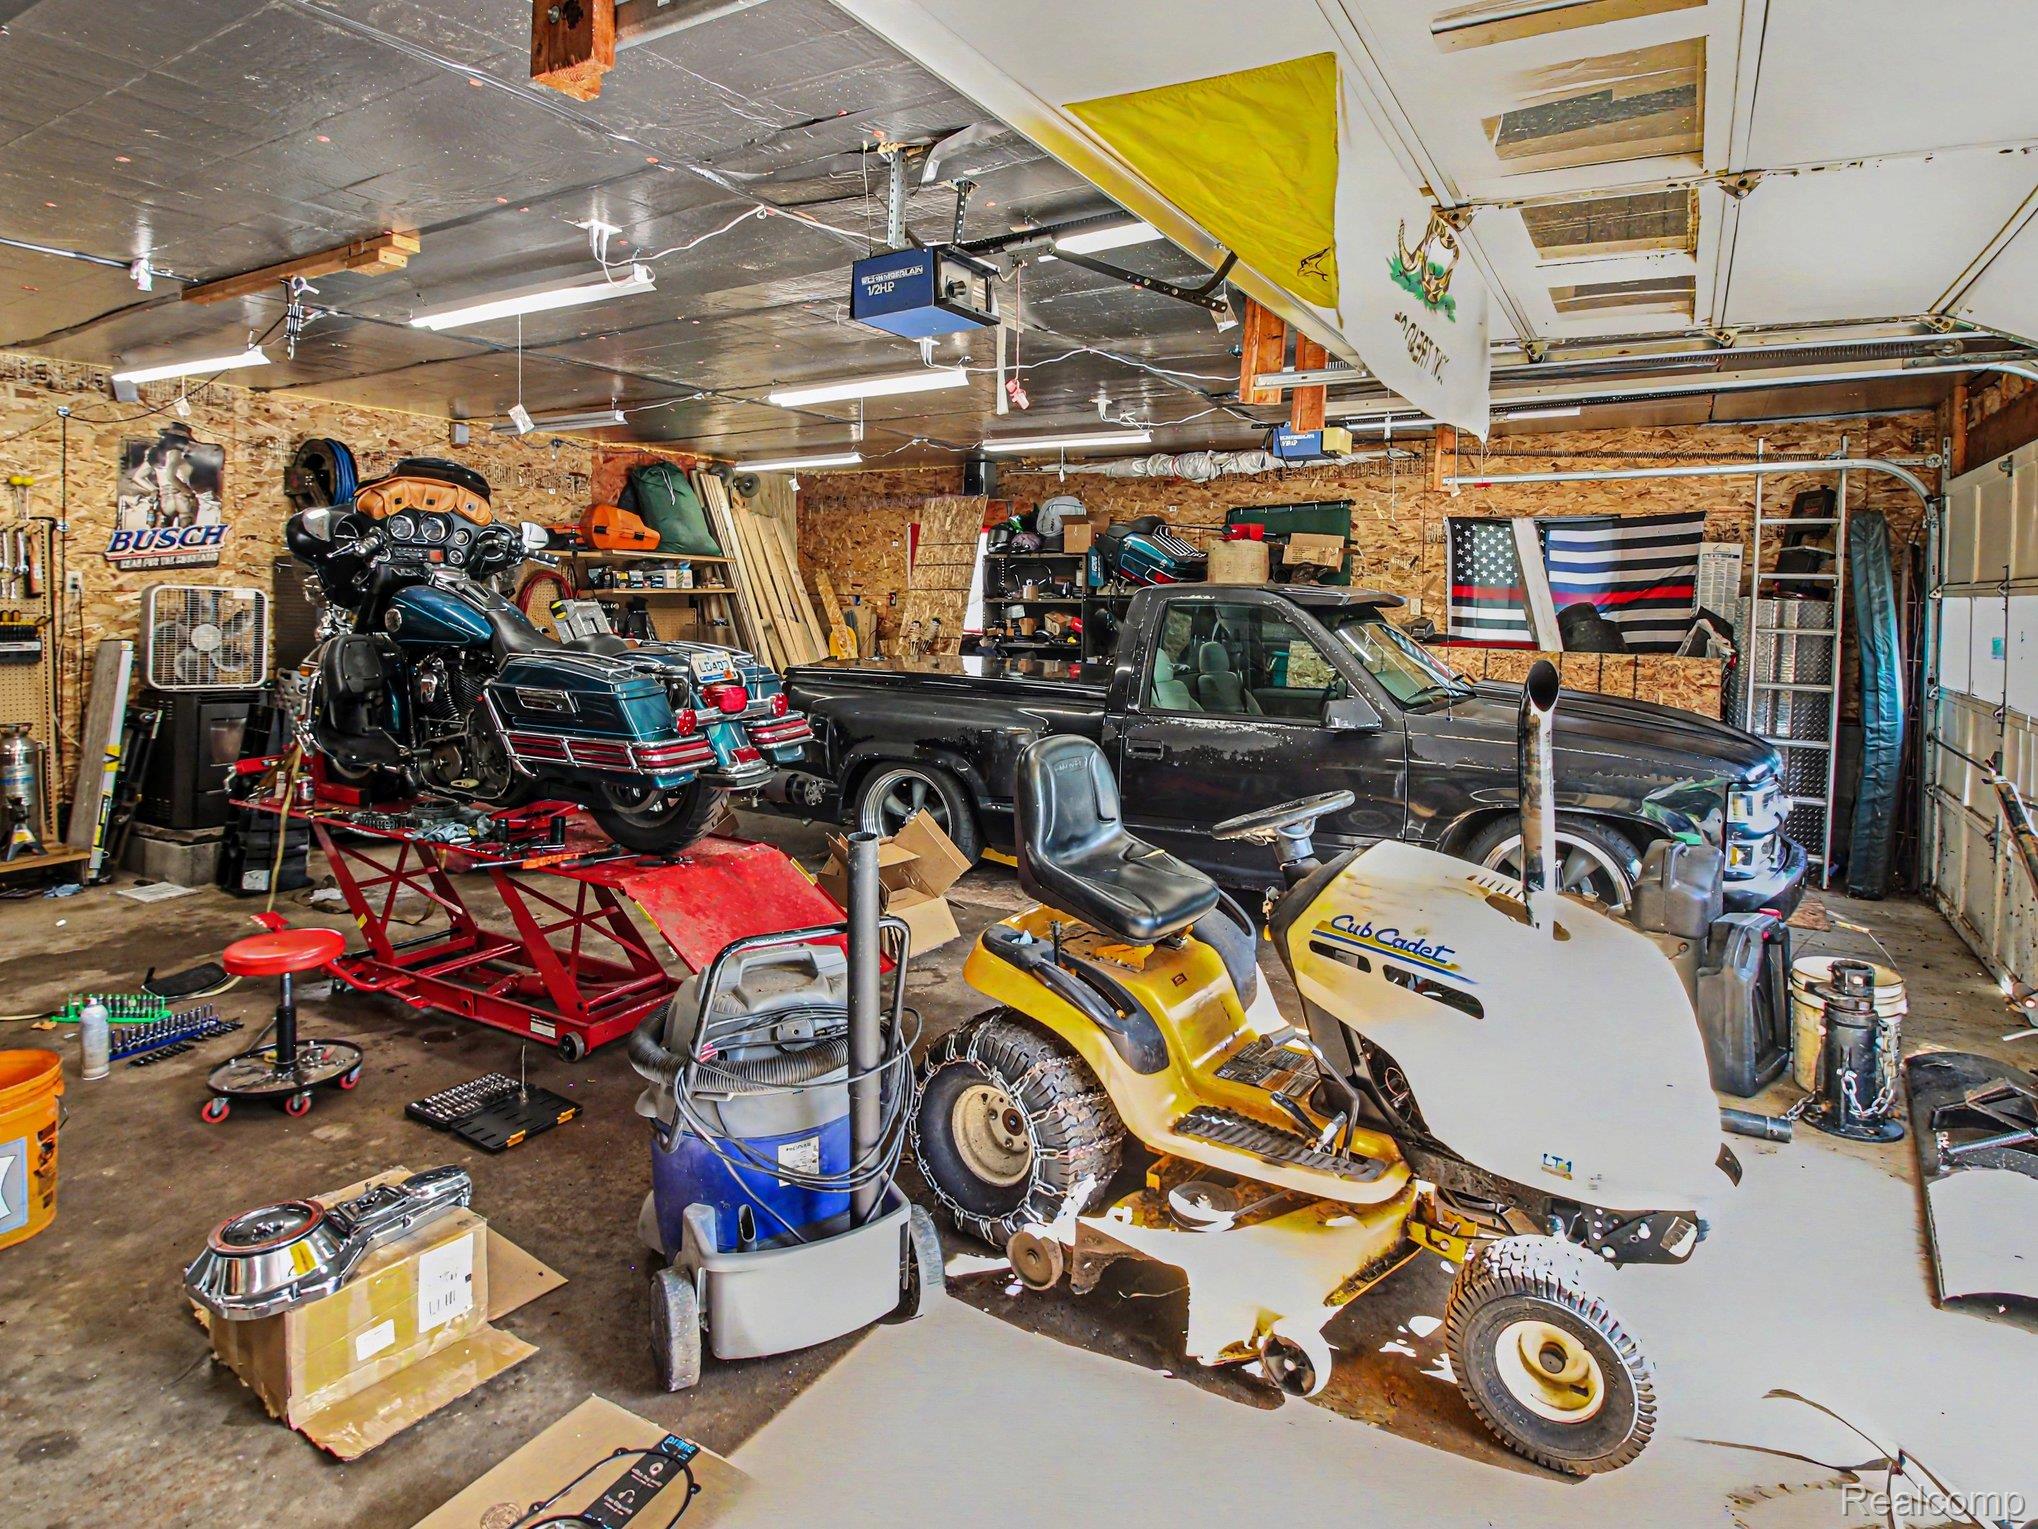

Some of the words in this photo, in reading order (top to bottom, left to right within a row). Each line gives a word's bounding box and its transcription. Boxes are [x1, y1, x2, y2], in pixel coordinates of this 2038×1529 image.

[106, 524, 229, 553] BUSCH
[1331, 914, 1373, 938] Cub
[1375, 928, 1456, 964] Cadet
[663, 1436, 696, 1454] prime
